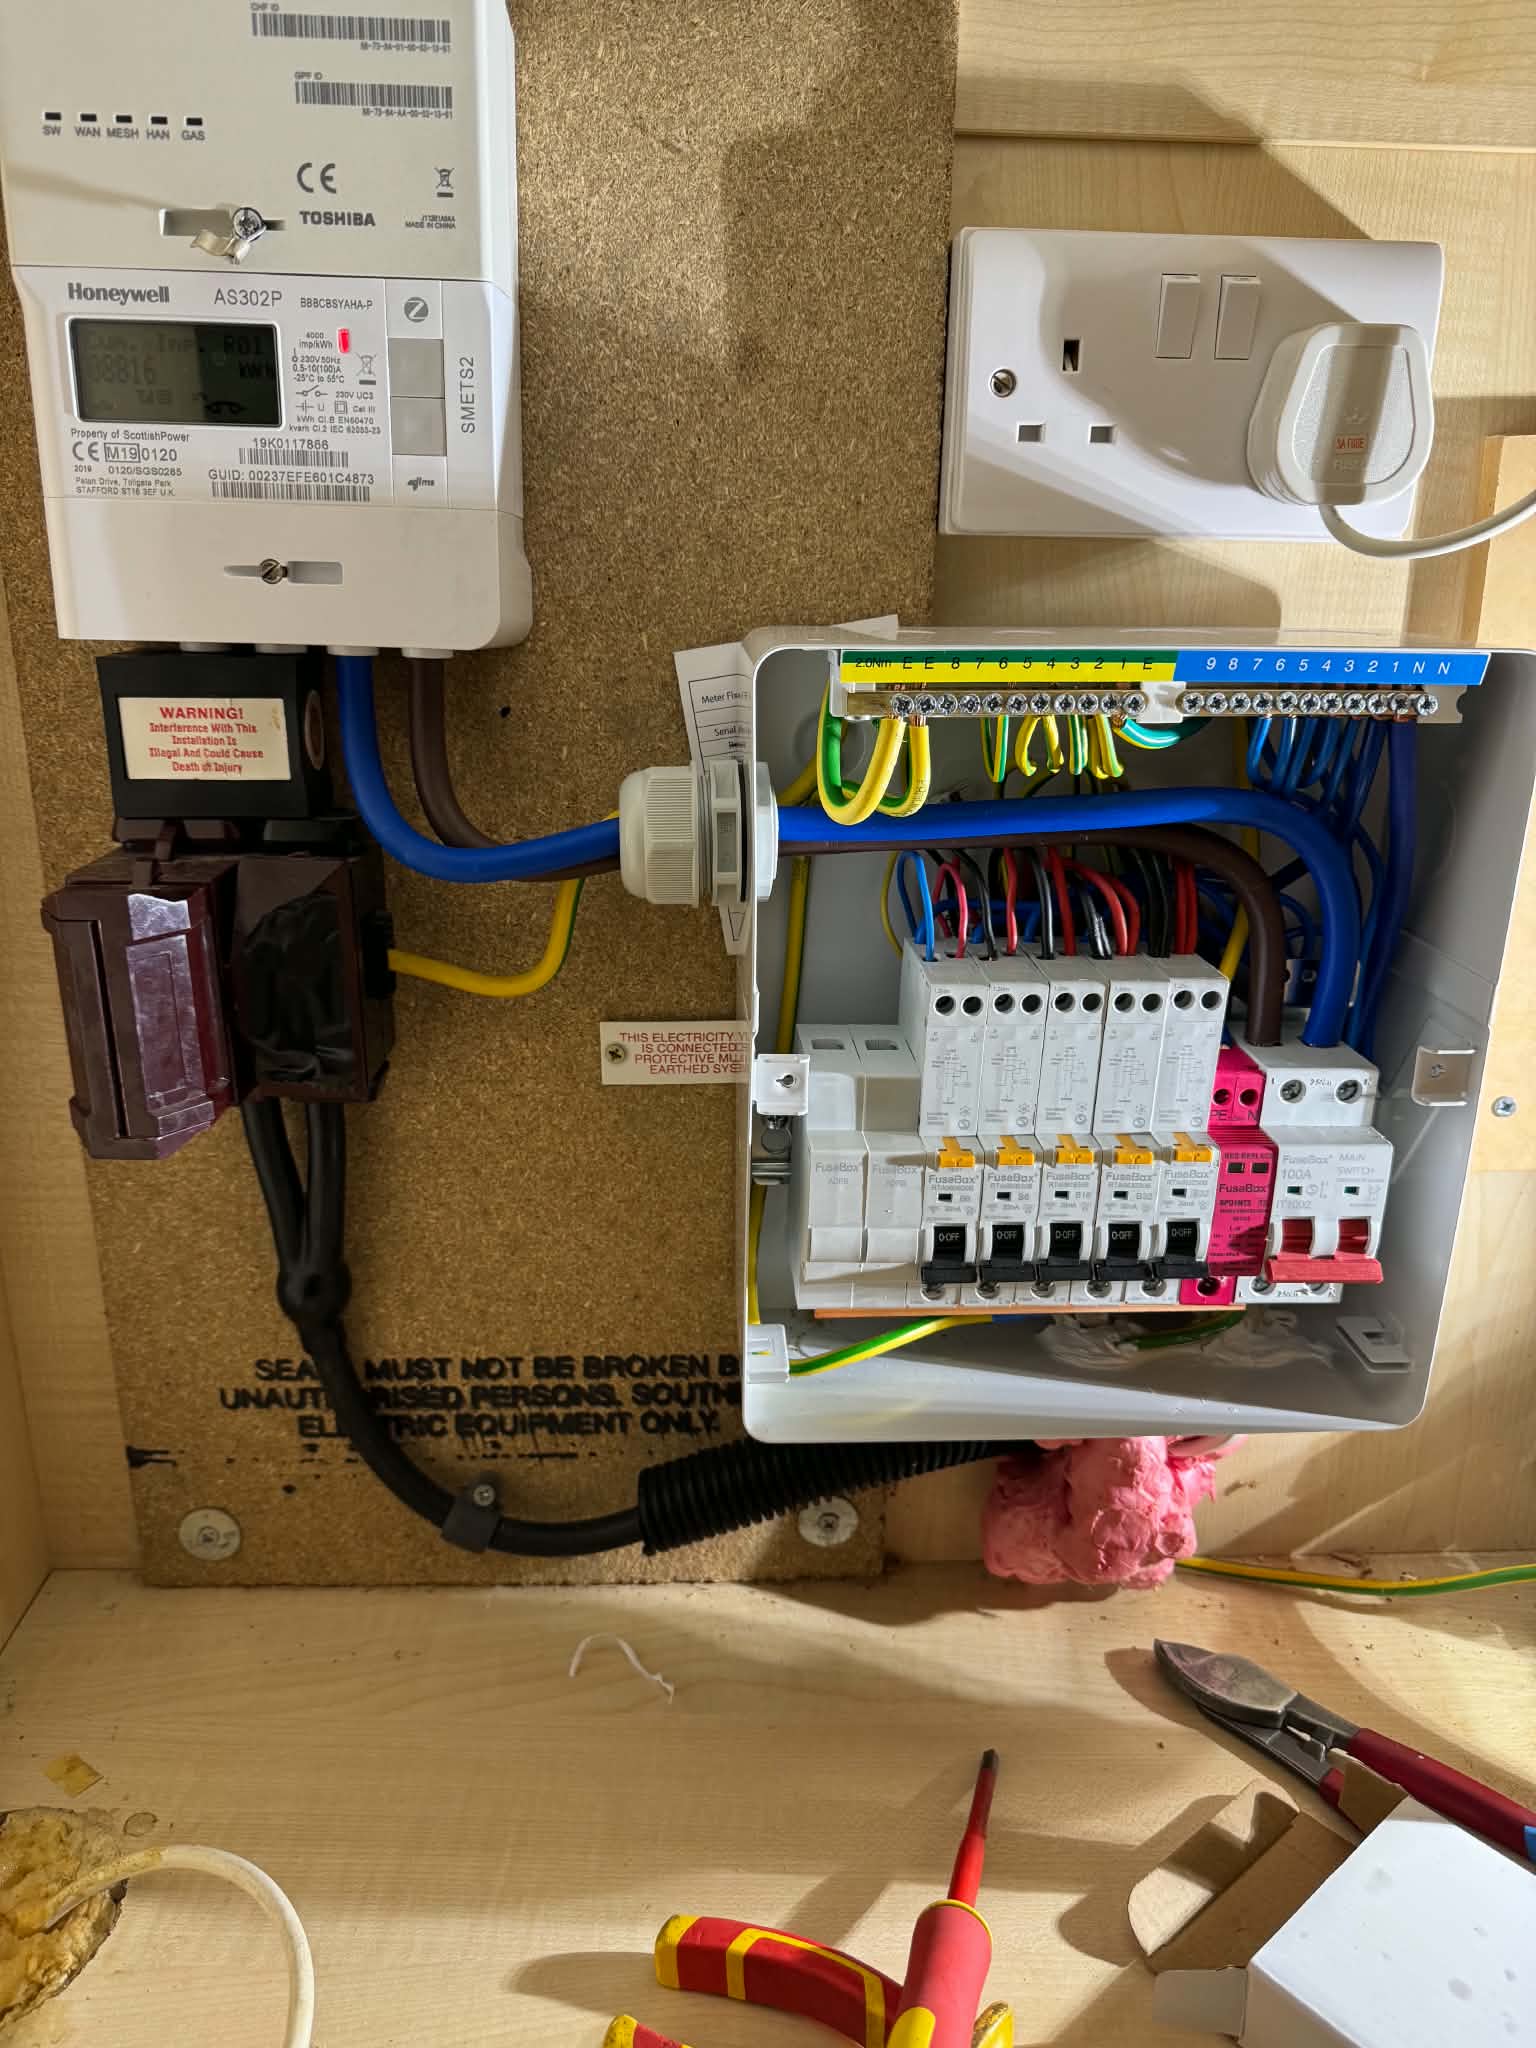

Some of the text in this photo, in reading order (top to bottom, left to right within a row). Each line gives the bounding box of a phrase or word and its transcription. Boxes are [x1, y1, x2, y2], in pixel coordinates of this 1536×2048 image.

[42, 125, 61, 136] SW
[75, 127, 100, 137] WAN
[107, 128, 139, 139] MESH
[146, 129, 170, 140] HAN
[181, 130, 205, 141] GAS
[299, 211, 375, 227] TOSHIBA
[67, 282, 170, 306] Honeywell
[214, 288, 283, 307] AS302P
[299, 340, 333, 350] imp/kWh
[292, 363, 341, 375] 0.5-10(100)A
[458, 356, 476, 434] SMETS2
[330, 425, 344, 433] IEC
[71, 428, 190, 442] Property of ScottishPower
[107, 447, 138, 460] M19
[141, 447, 178, 462] 0120
[208, 469, 245, 481] GUID:
[99, 478, 121, 486] Drive,
[76, 487, 119, 496] STAFFORD
[902, 656, 914, 670] E
[924, 656, 936, 670] E
[950, 656, 961, 670] 8
[975, 656, 985, 670] 7
[998, 656, 1009, 670] 6
[1022, 656, 1033, 670] 5
[1045, 656, 1056, 670] 4
[1070, 656, 1081, 670] 3
[1093, 656, 1105, 670] 2
[1141, 656, 1154, 671] E
[1205, 656, 1452, 676] 9 8 7 6 5 4 3 2 1 N N
[701, 693, 726, 705] Meter
[159, 707, 244, 720] WARNING!
[149, 722, 258, 733] Interference With This
[172, 736, 237, 746] Installation Is
[149, 747, 264, 760] Illegal And Could Cause
[171, 761, 200, 772] Death
[214, 761, 243, 776] Injury
[620, 1032, 735, 1043] THIS ELECTRICITY
[641, 1043, 737, 1053] IS CONNECTED
[635, 1054, 715, 1064] PROTECTIVE
[650, 1064, 709, 1075] EARTHED
[1282, 1154, 1328, 1164] FuseBox
[815, 1162, 858, 1172] FuseBox
[872, 1164, 918, 1175] FuseBox
[928, 1174, 976, 1184] FuseBox
[987, 1172, 1034, 1182] FuseBox
[1047, 1171, 1091, 1181] FuseBox
[1106, 1171, 1152, 1181] FuseBox
[1165, 1169, 1210, 1179] FuseBox
[1281, 1169, 1312, 1180] 100A
[1218, 1183, 1267, 1193] FuseBox
[255, 1354, 740, 1381] SEA MUST NOT BE BROKEN B
[219, 1385, 466, 1411] UNAUTRISED
[455, 1411, 633, 1437] EQUIPMENT
